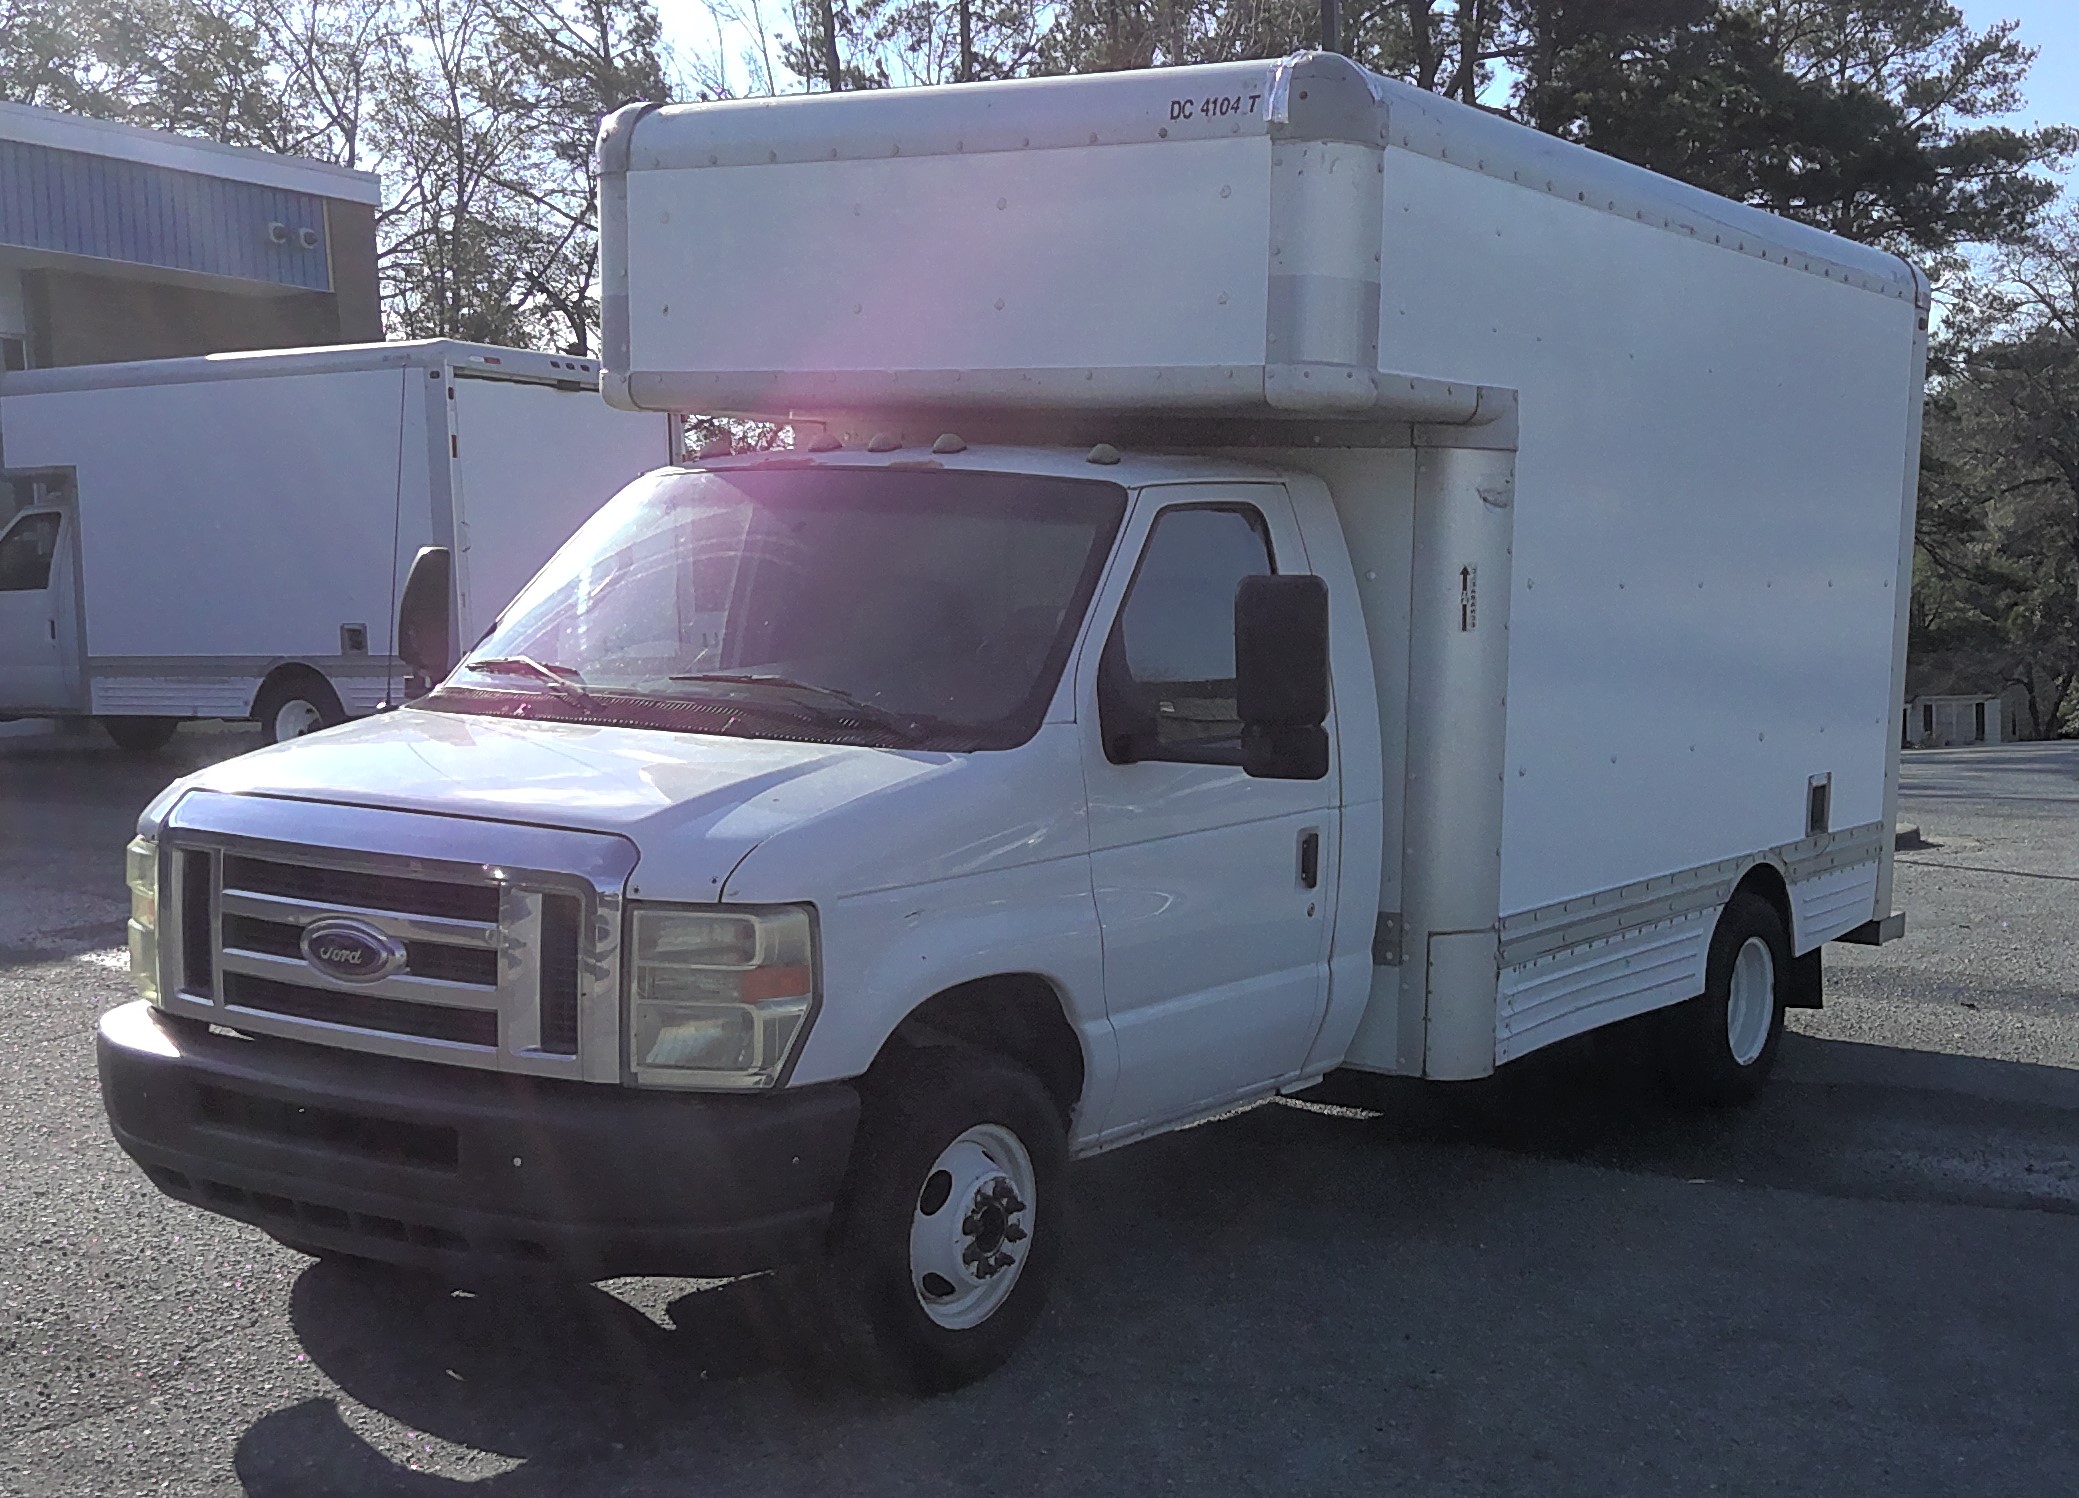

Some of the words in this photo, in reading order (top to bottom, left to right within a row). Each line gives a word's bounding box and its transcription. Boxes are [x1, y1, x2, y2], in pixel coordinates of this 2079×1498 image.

[1170, 99, 1194, 120] DC
[1200, 96, 1241, 116] 4104
[1248, 94, 1261, 113] T
[320, 947, 362, 964] Ford
